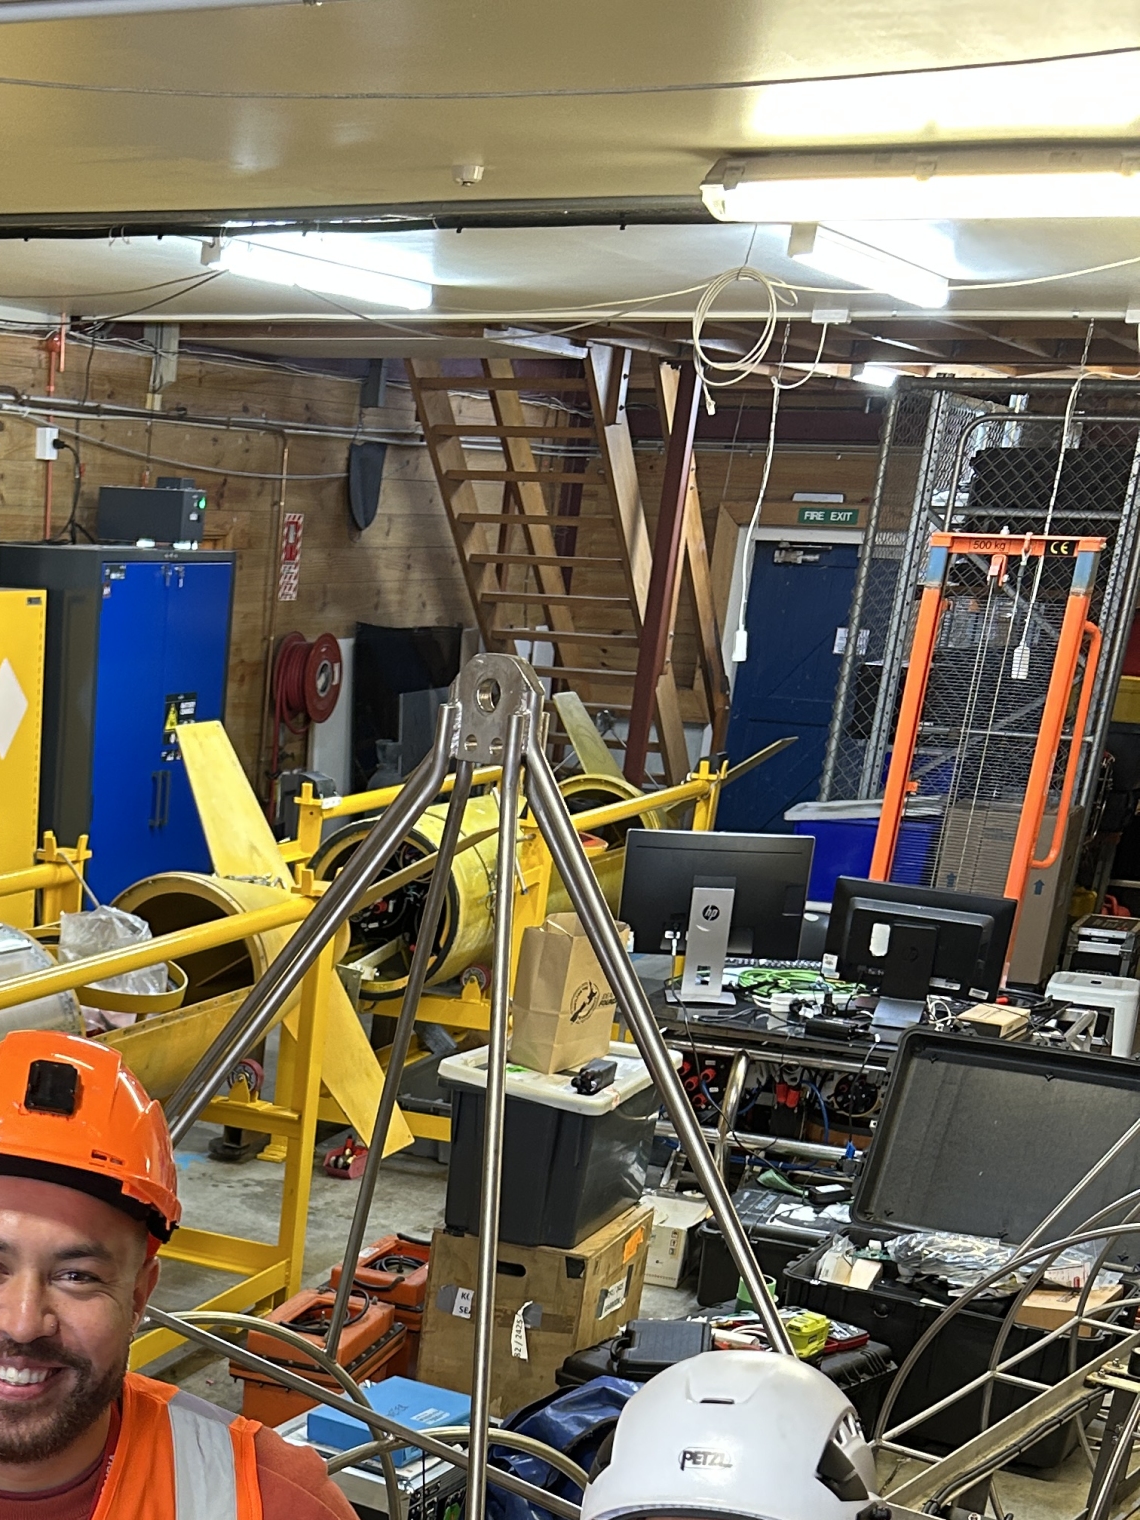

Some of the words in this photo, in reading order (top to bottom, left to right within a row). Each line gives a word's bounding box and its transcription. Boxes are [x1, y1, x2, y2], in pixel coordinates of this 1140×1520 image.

[804, 511, 825, 521] FIRE
[830, 511, 853, 522] EXIT
[973, 540, 991, 550] 500
[994, 540, 1007, 551] kg
[459, 1306, 471, 1314] SE
[680, 1450, 734, 1471] PETZL
